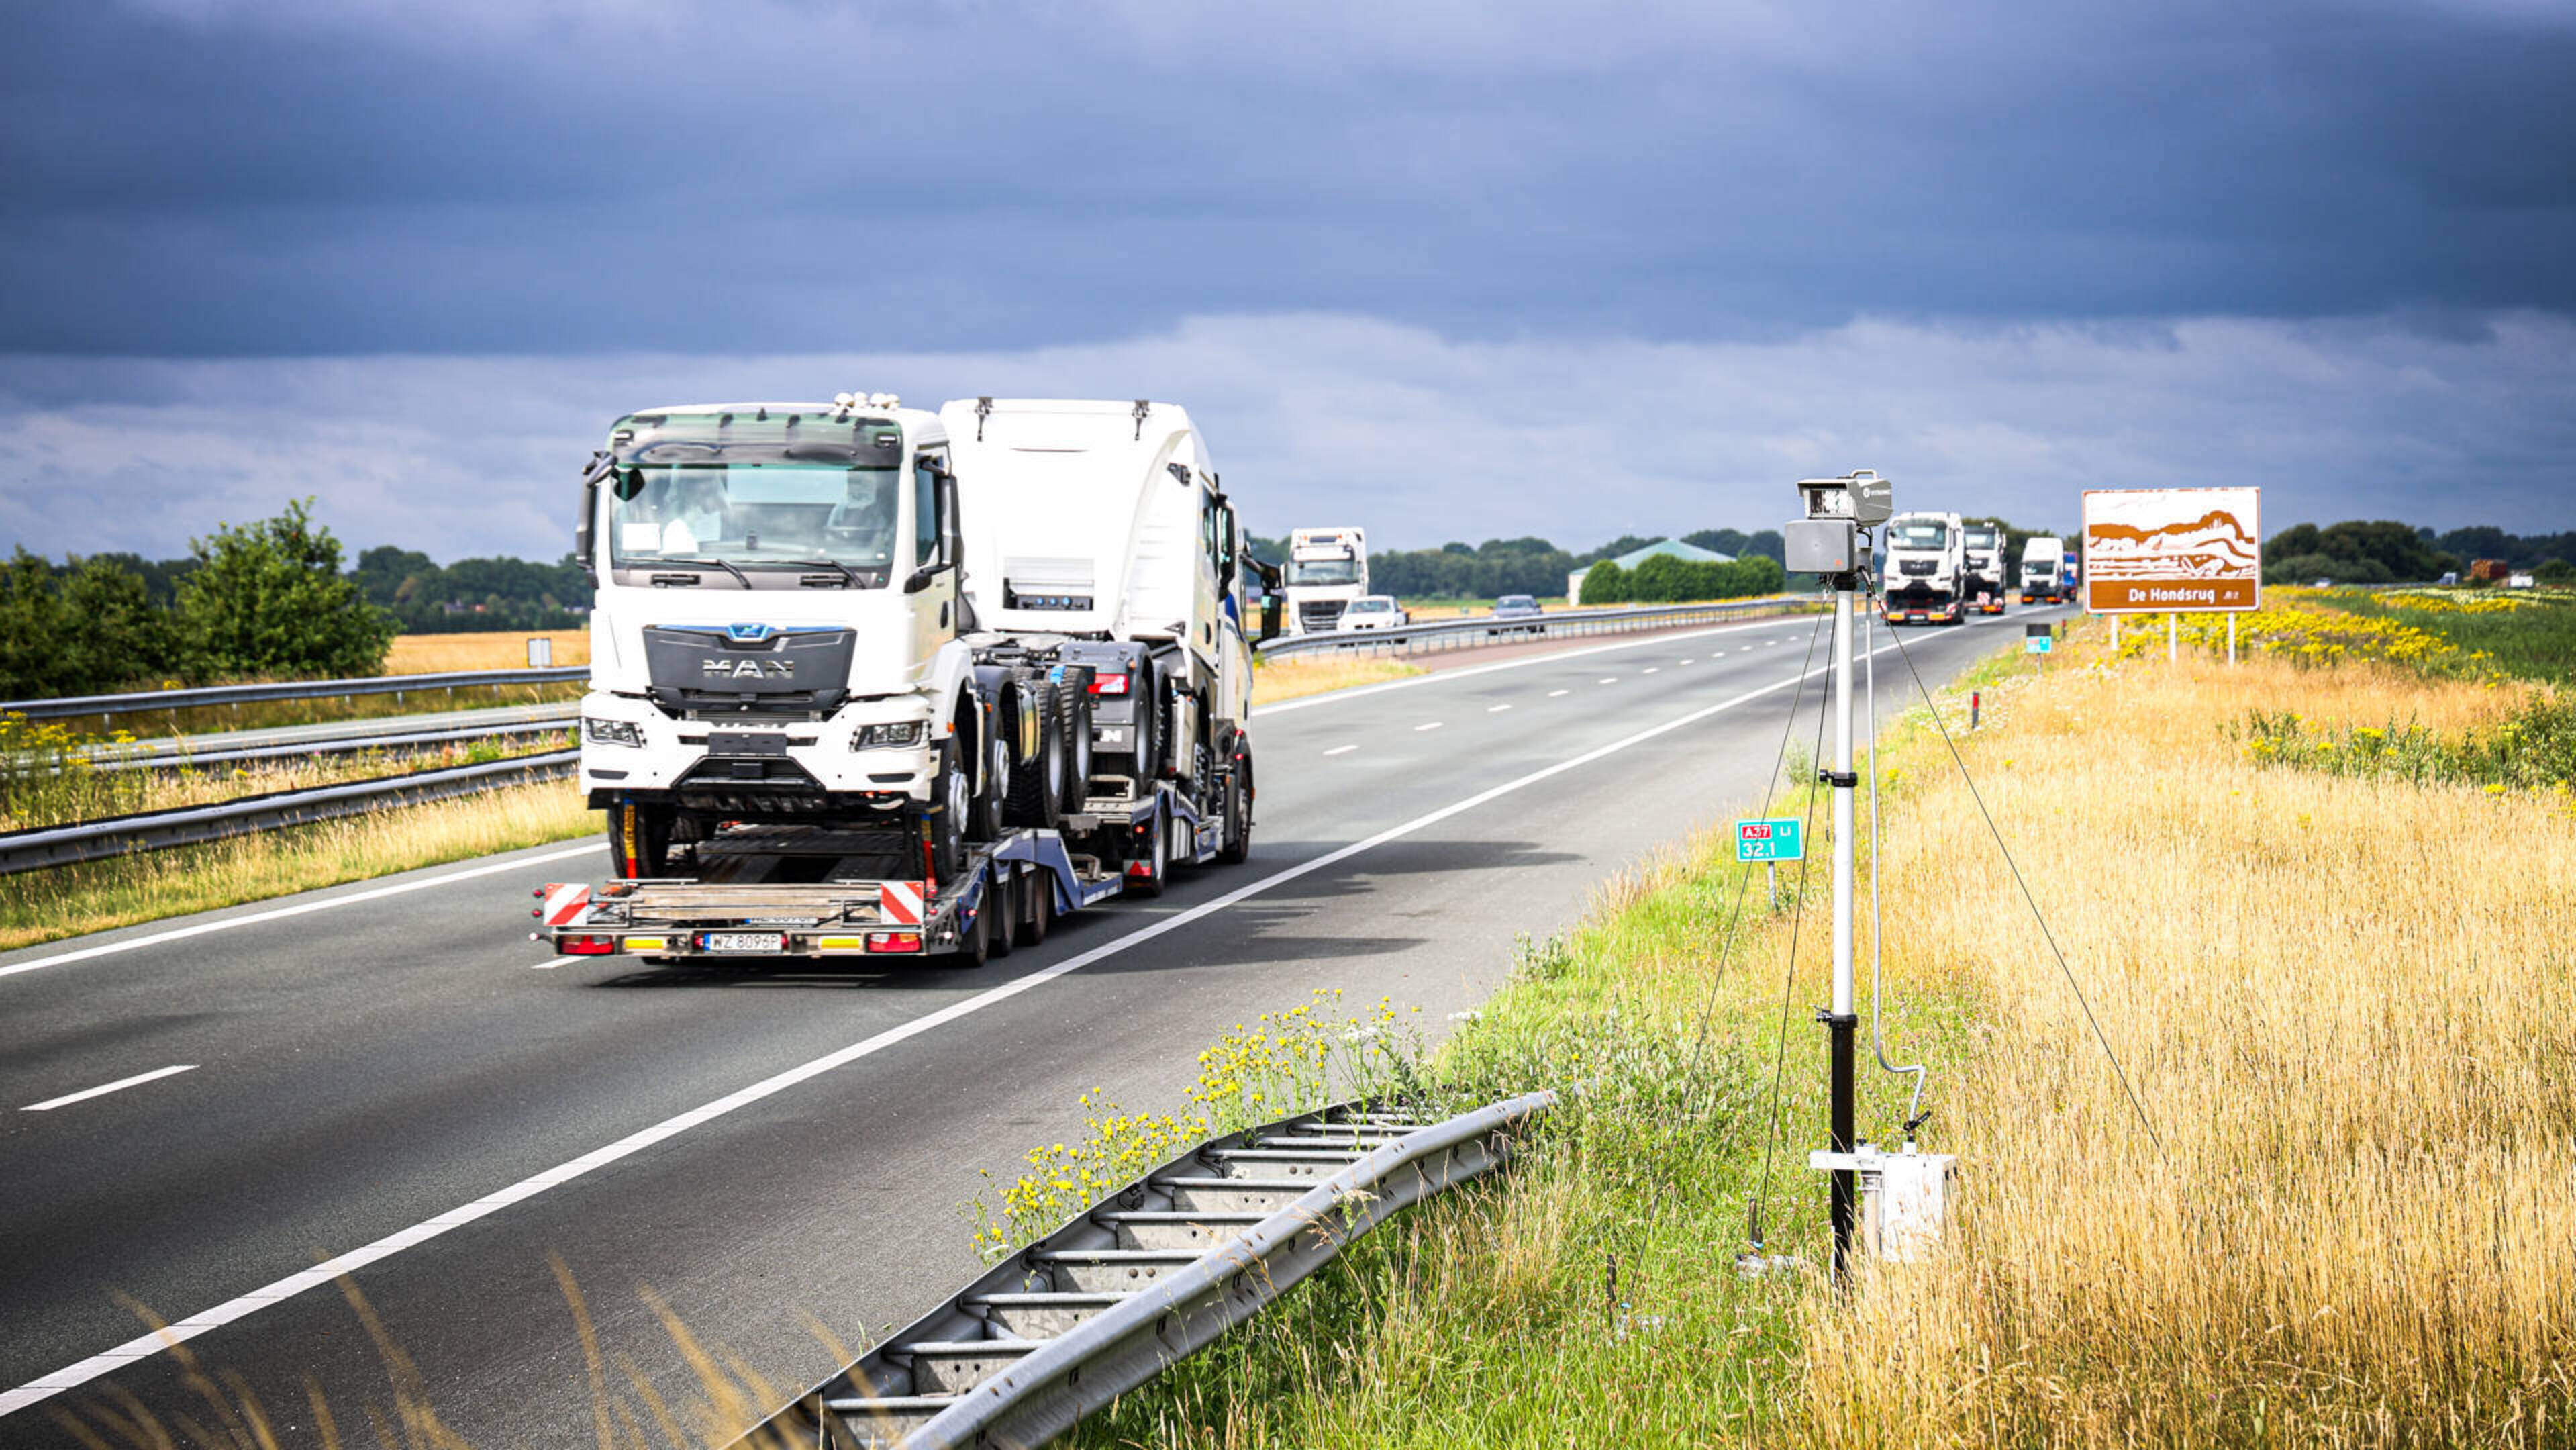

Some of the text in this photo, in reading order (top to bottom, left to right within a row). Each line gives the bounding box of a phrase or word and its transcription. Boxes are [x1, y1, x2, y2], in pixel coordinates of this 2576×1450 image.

[2128, 587, 2146, 602] De
[2150, 587, 2215, 604] Hondsrug
[703, 659, 795, 679] MAN
[1744, 826, 1769, 838] A37
[713, 935, 778, 949] WZ 8096P
